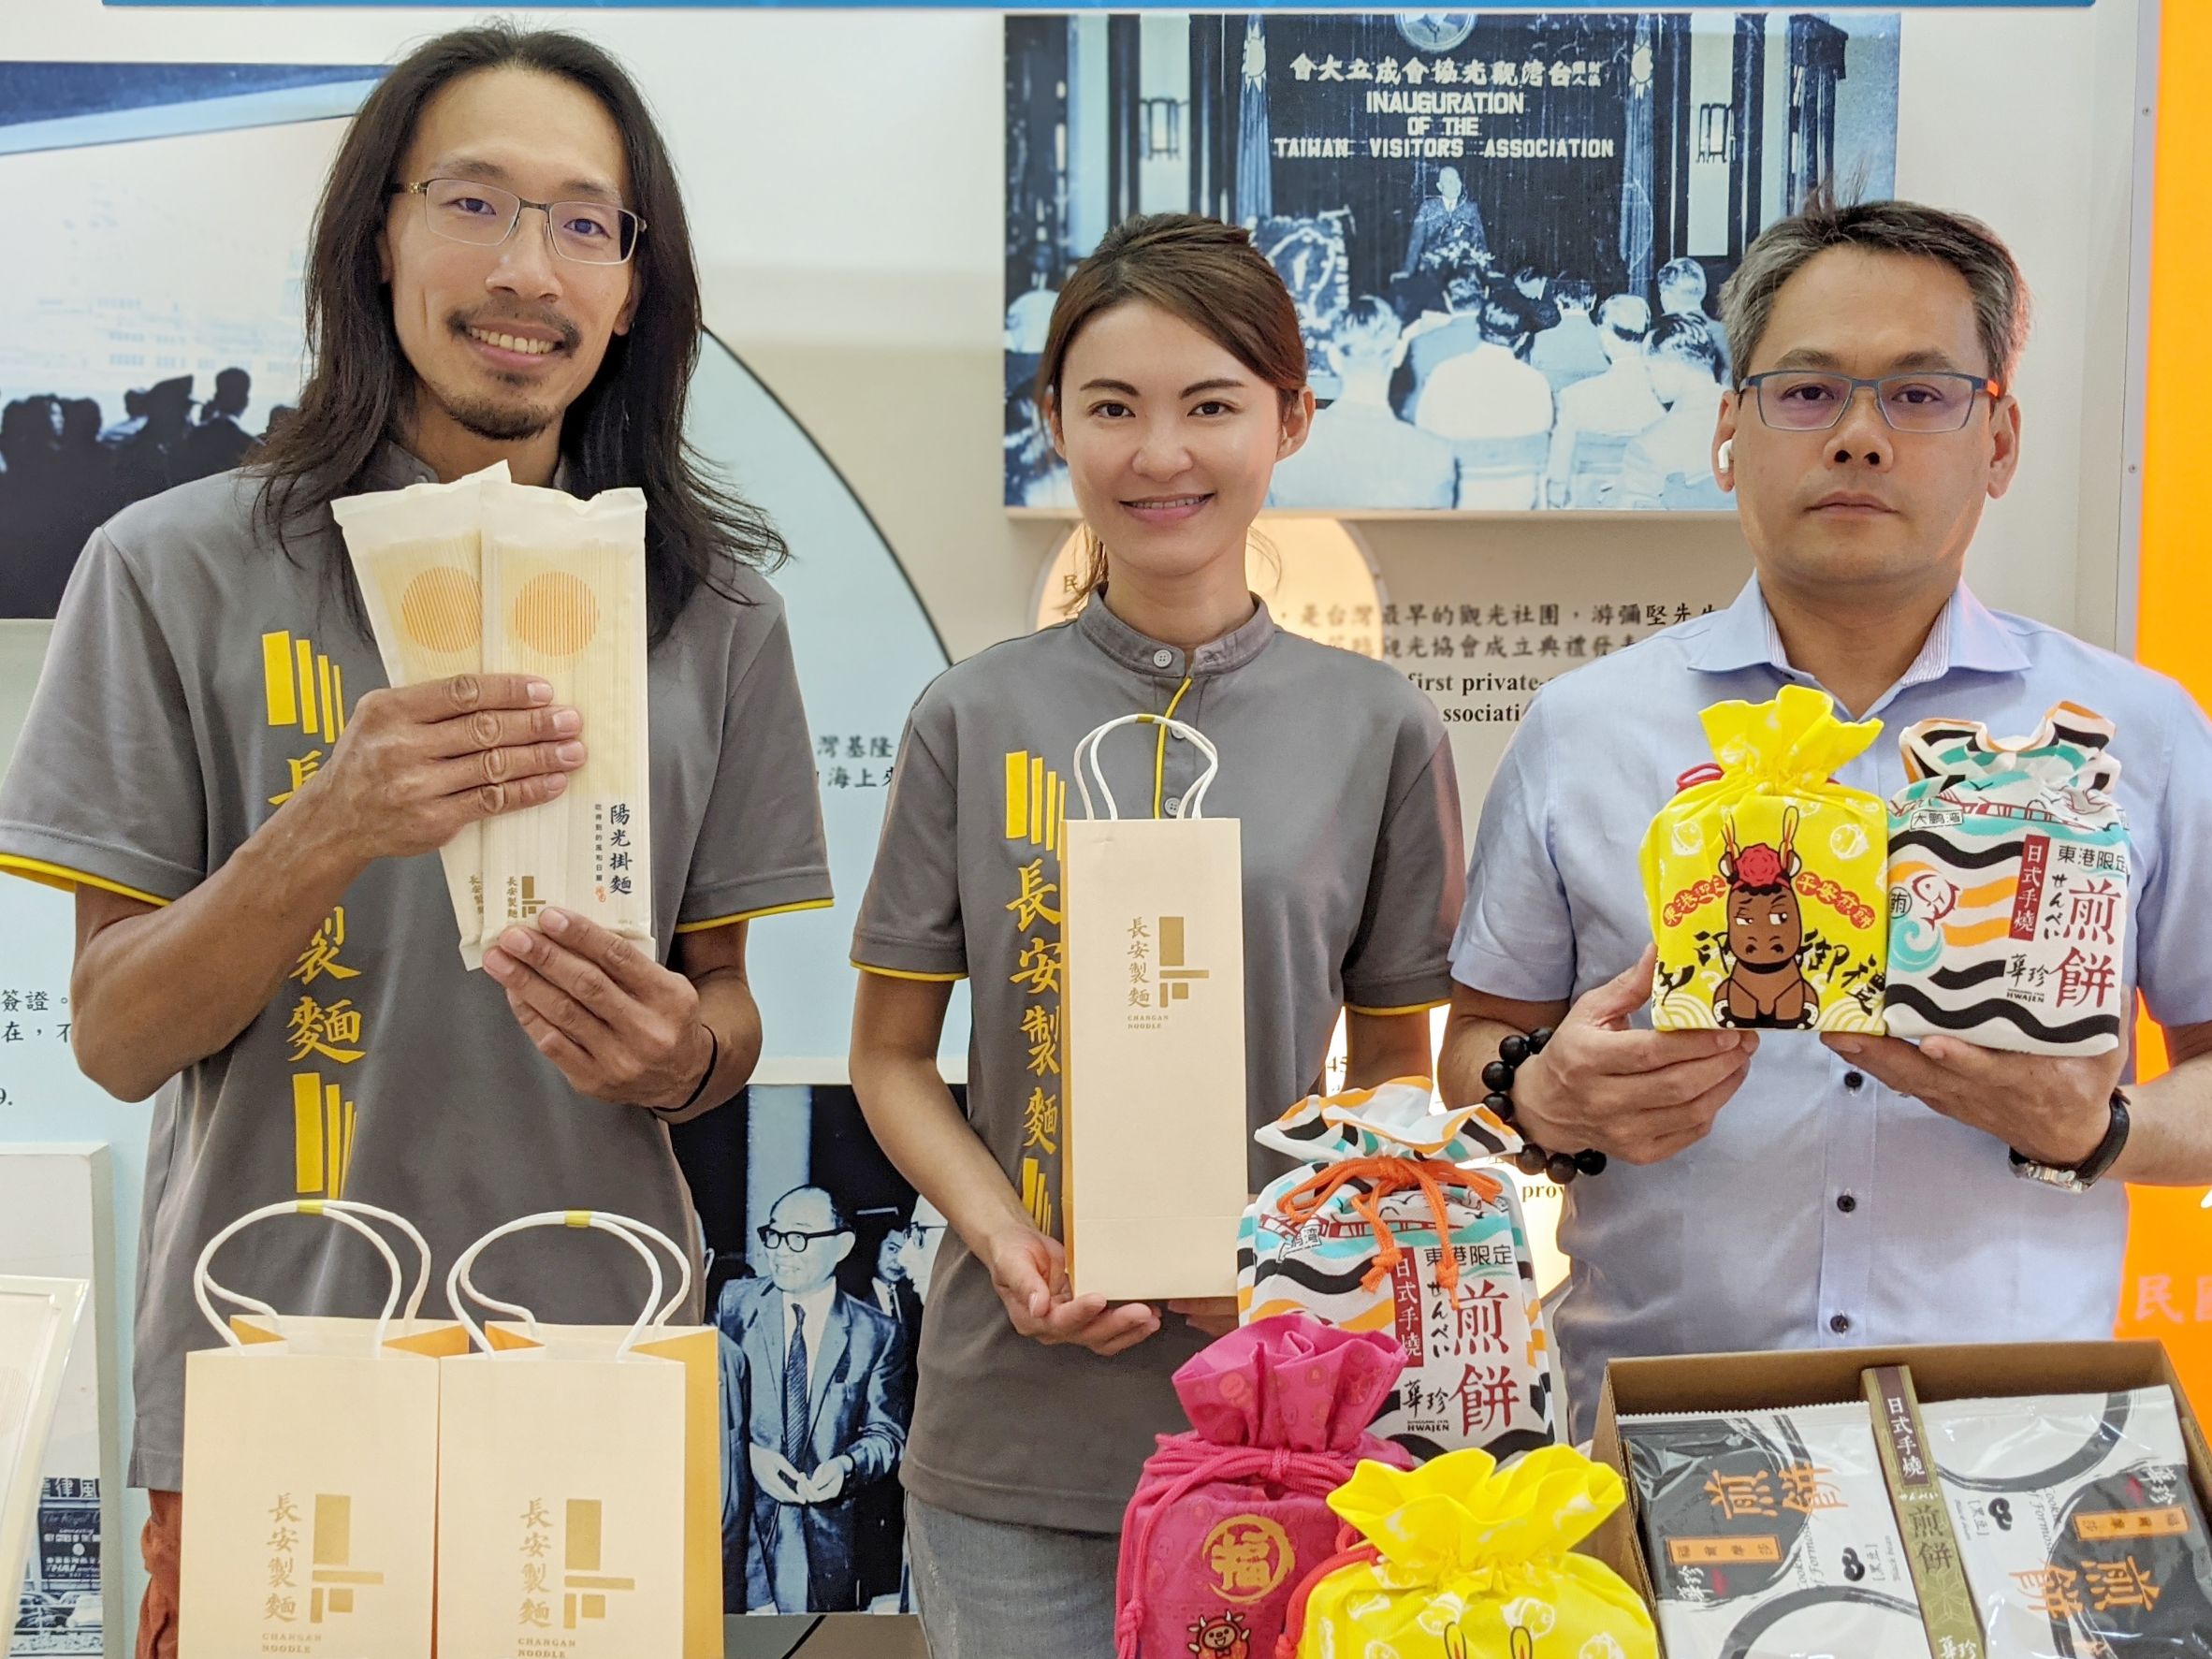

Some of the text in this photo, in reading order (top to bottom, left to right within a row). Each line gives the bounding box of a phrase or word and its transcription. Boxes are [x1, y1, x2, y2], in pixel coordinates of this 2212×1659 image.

[1366, 92, 1524, 114] INAUGURATION
[1407, 117, 1479, 136] OF THE
[1273, 138, 1614, 158] TAIWAN VISITORS ASSOCIATION
[1443, 704, 1521, 722] ssociati
[1463, 673, 1555, 696] private-
[609, 803, 633, 895] 陽光掛麵
[268, 749, 367, 1064] 長製麵
[2012, 843, 2044, 936] 日式手燒
[1126, 916, 1152, 1009] 長安製麵
[2049, 878, 2122, 1010] 煎餅
[1004, 857, 1062, 1156] 長安製麵
[1395, 1259, 1422, 1357] 日式手燒
[1448, 1279, 1520, 1437] 煎餅
[1406, 1423, 1450, 1433] HWAJEN
[1887, 1397, 1925, 1478] 日式手燒
[264, 1492, 301, 1623] 長安製麵
[518, 1497, 554, 1628] 長安製麵
[1211, 1530, 1272, 1591] 福
[1909, 1505, 1953, 1574] 煎餅
[262, 1644, 311, 1653] NOODLE
[517, 1637, 576, 1648] CHANGAN
[517, 1649, 566, 1659] NOODLE
